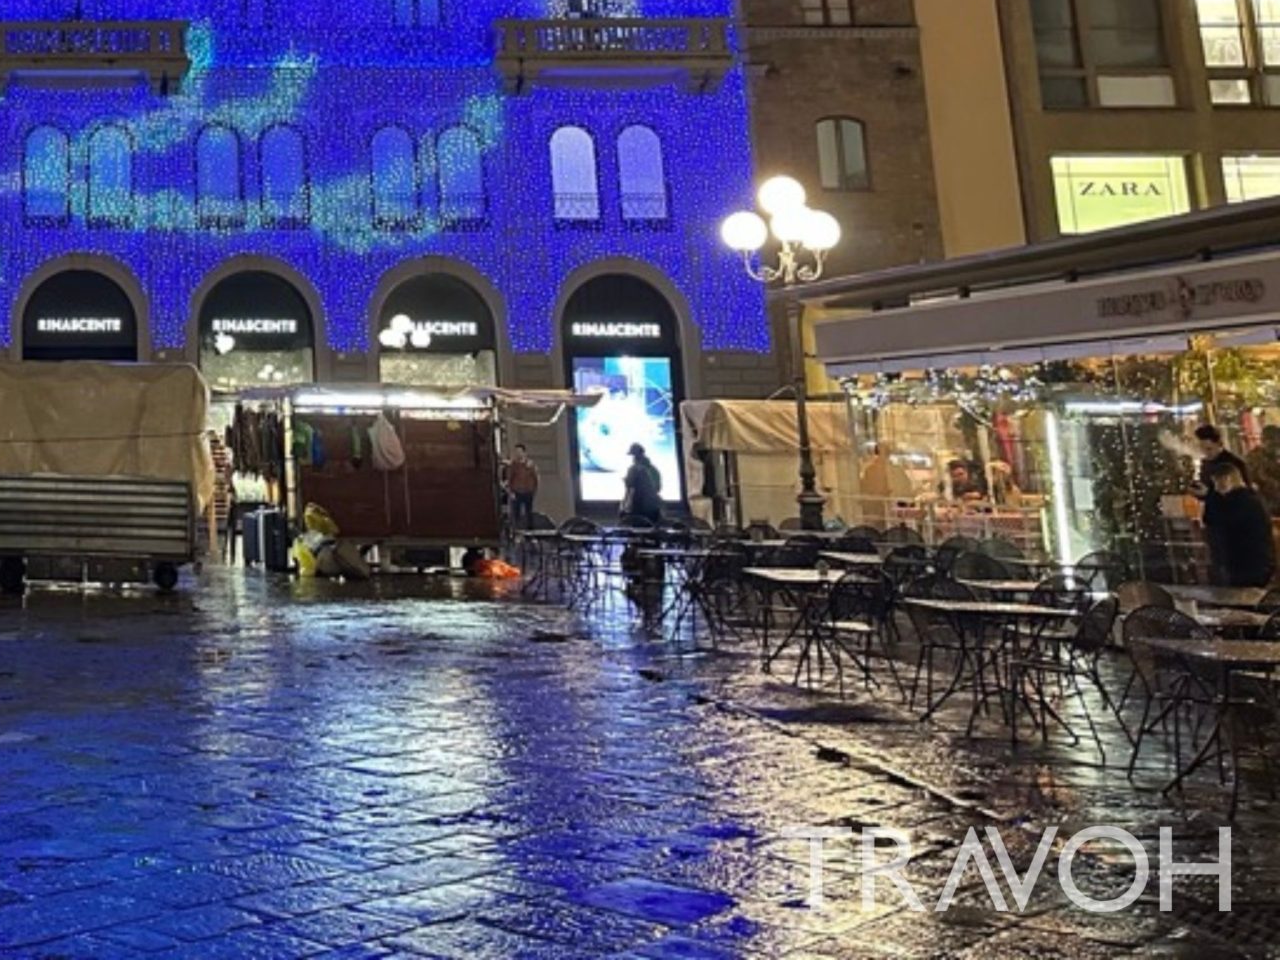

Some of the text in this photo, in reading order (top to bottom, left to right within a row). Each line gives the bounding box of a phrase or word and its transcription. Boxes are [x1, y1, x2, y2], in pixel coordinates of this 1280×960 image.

[1079, 181, 1165, 196] ZARA
[37, 318, 121, 331] RINASCENTE
[212, 319, 297, 333] RINASCENTE
[572, 322, 661, 337] RINASCENTE
